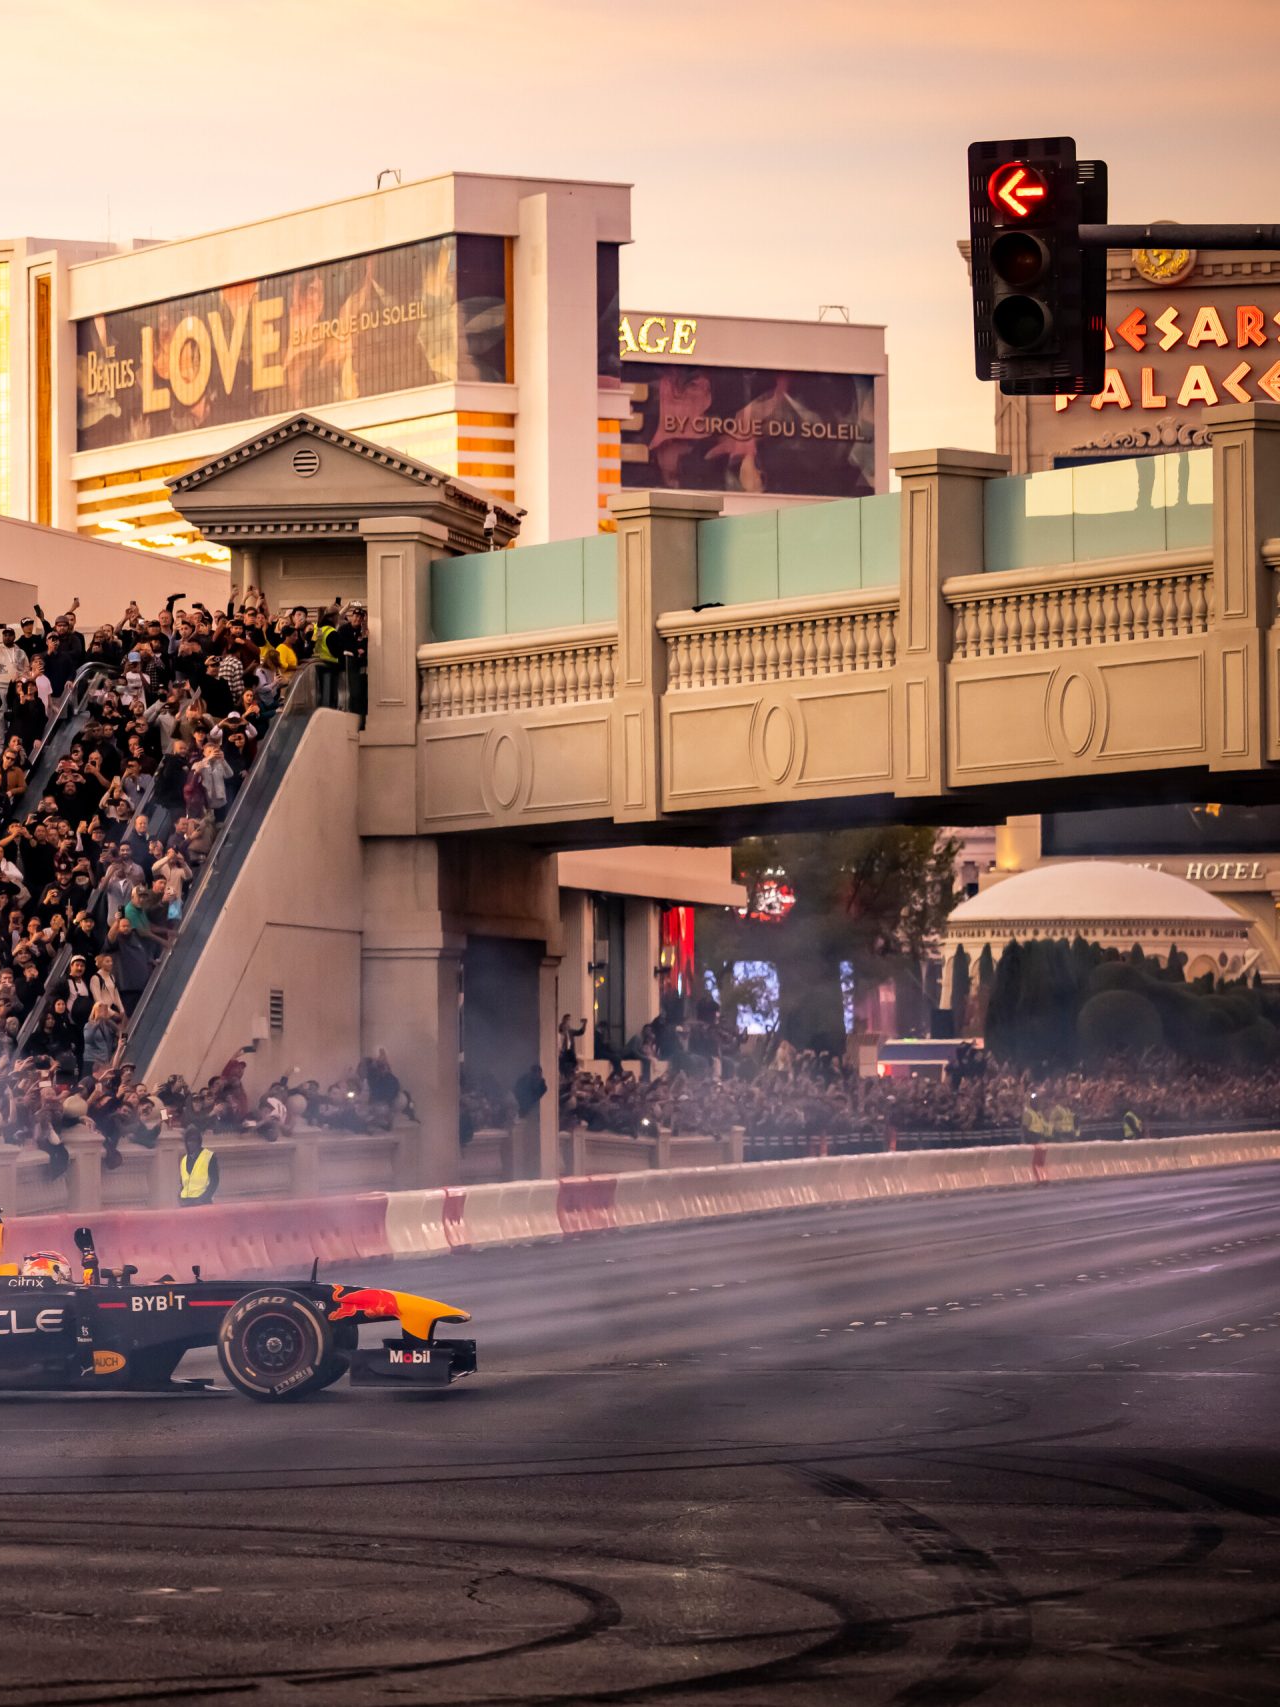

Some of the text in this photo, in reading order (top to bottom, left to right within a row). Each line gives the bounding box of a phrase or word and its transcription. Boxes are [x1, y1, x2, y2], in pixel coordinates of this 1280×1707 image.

[311, 315, 358, 341] CIRQUE
[361, 310, 380, 331] DU
[382, 301, 427, 326] SOLEIL
[1105, 305, 1280, 352] ESAR
[619, 317, 697, 356] AGE
[141, 297, 284, 414] LOVE
[664, 416, 864, 441] BY CIRQUE DU SOLEIL
[1186, 862, 1264, 880] HOTEL
[8, 1276, 44, 1288] citrix
[131, 1291, 186, 1312] BYBIT
[389, 1350, 430, 1364] Mobil
